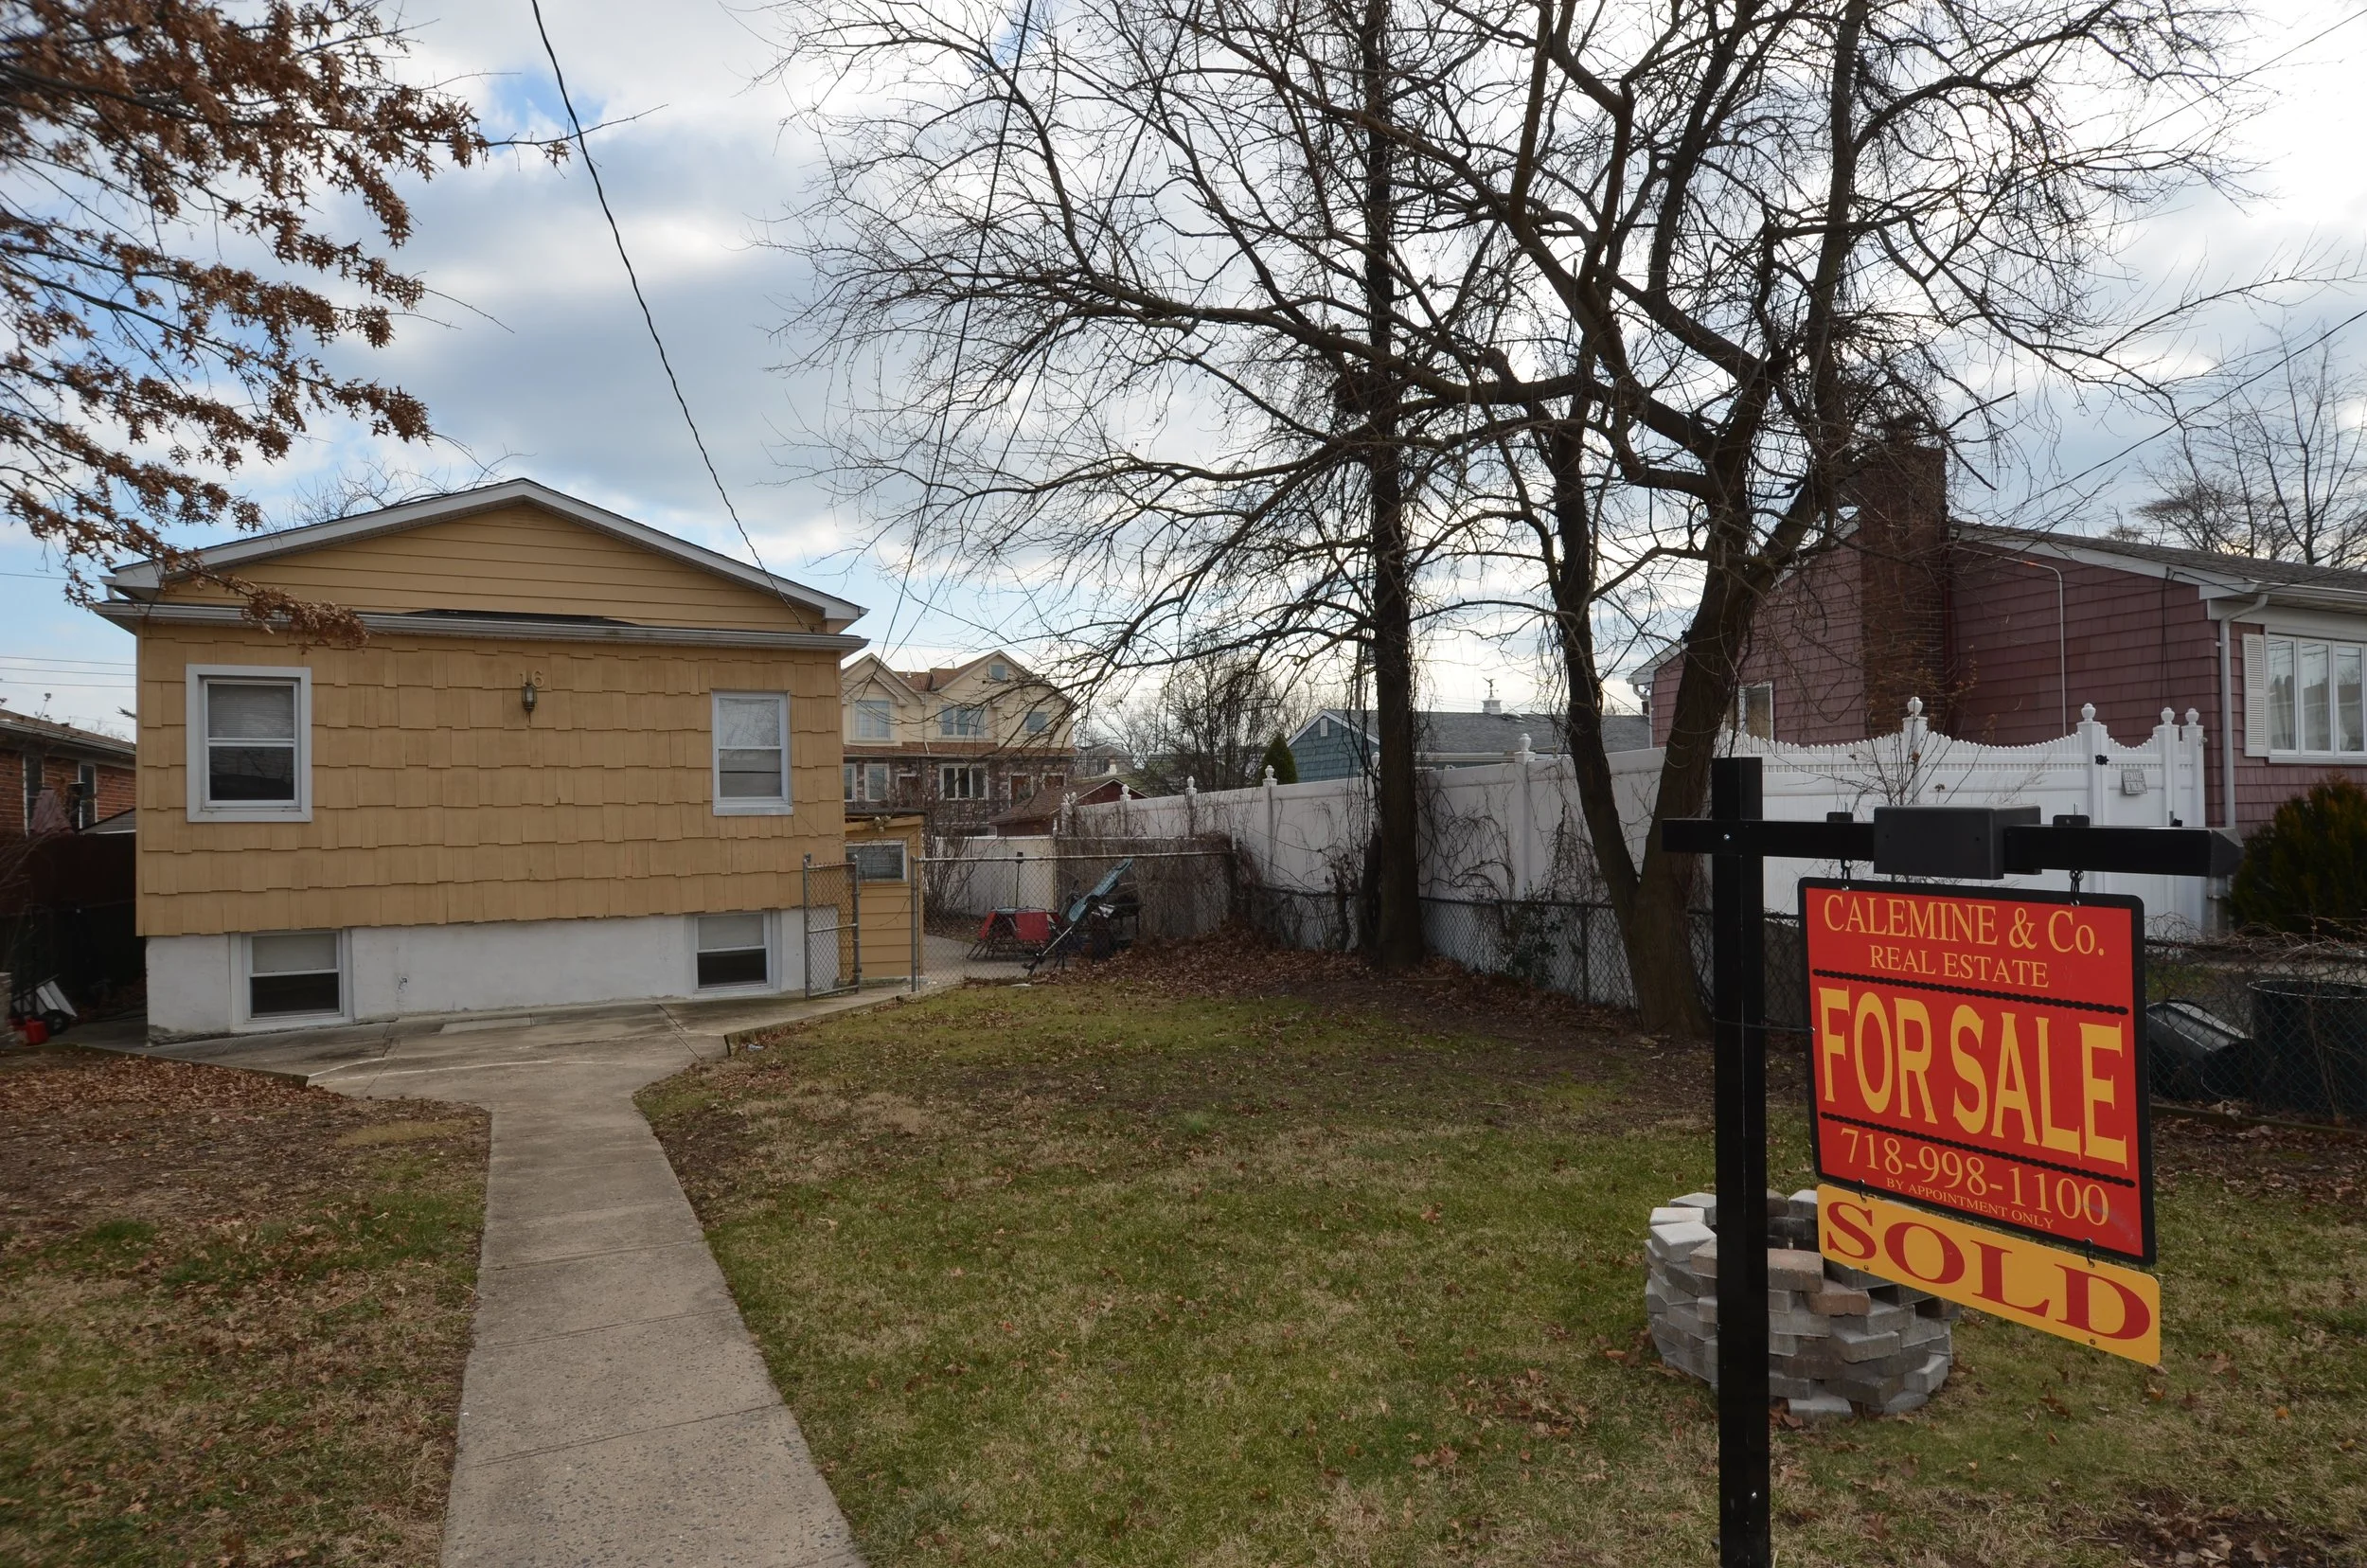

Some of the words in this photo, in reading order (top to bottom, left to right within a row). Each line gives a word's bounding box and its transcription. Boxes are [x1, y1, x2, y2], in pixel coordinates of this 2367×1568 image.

[520, 670, 544, 688] 16
[1824, 894, 1998, 946] CALEMINE
[2008, 907, 2038, 950] &
[2048, 910, 2105, 956] Co.
[1869, 945, 1936, 974] REAL
[1942, 952, 2049, 989] ESTATE
[1818, 986, 1938, 1125] FOR
[1950, 1004, 2127, 1170] SALE
[1841, 1128, 2110, 1227] 718-998-1100
[1886, 1177, 1904, 1190] BY
[1908, 1184, 2007, 1217] APPOINTMENT
[2011, 1209, 2054, 1230] ONLY
[1825, 1201, 2151, 1341] SOLD
